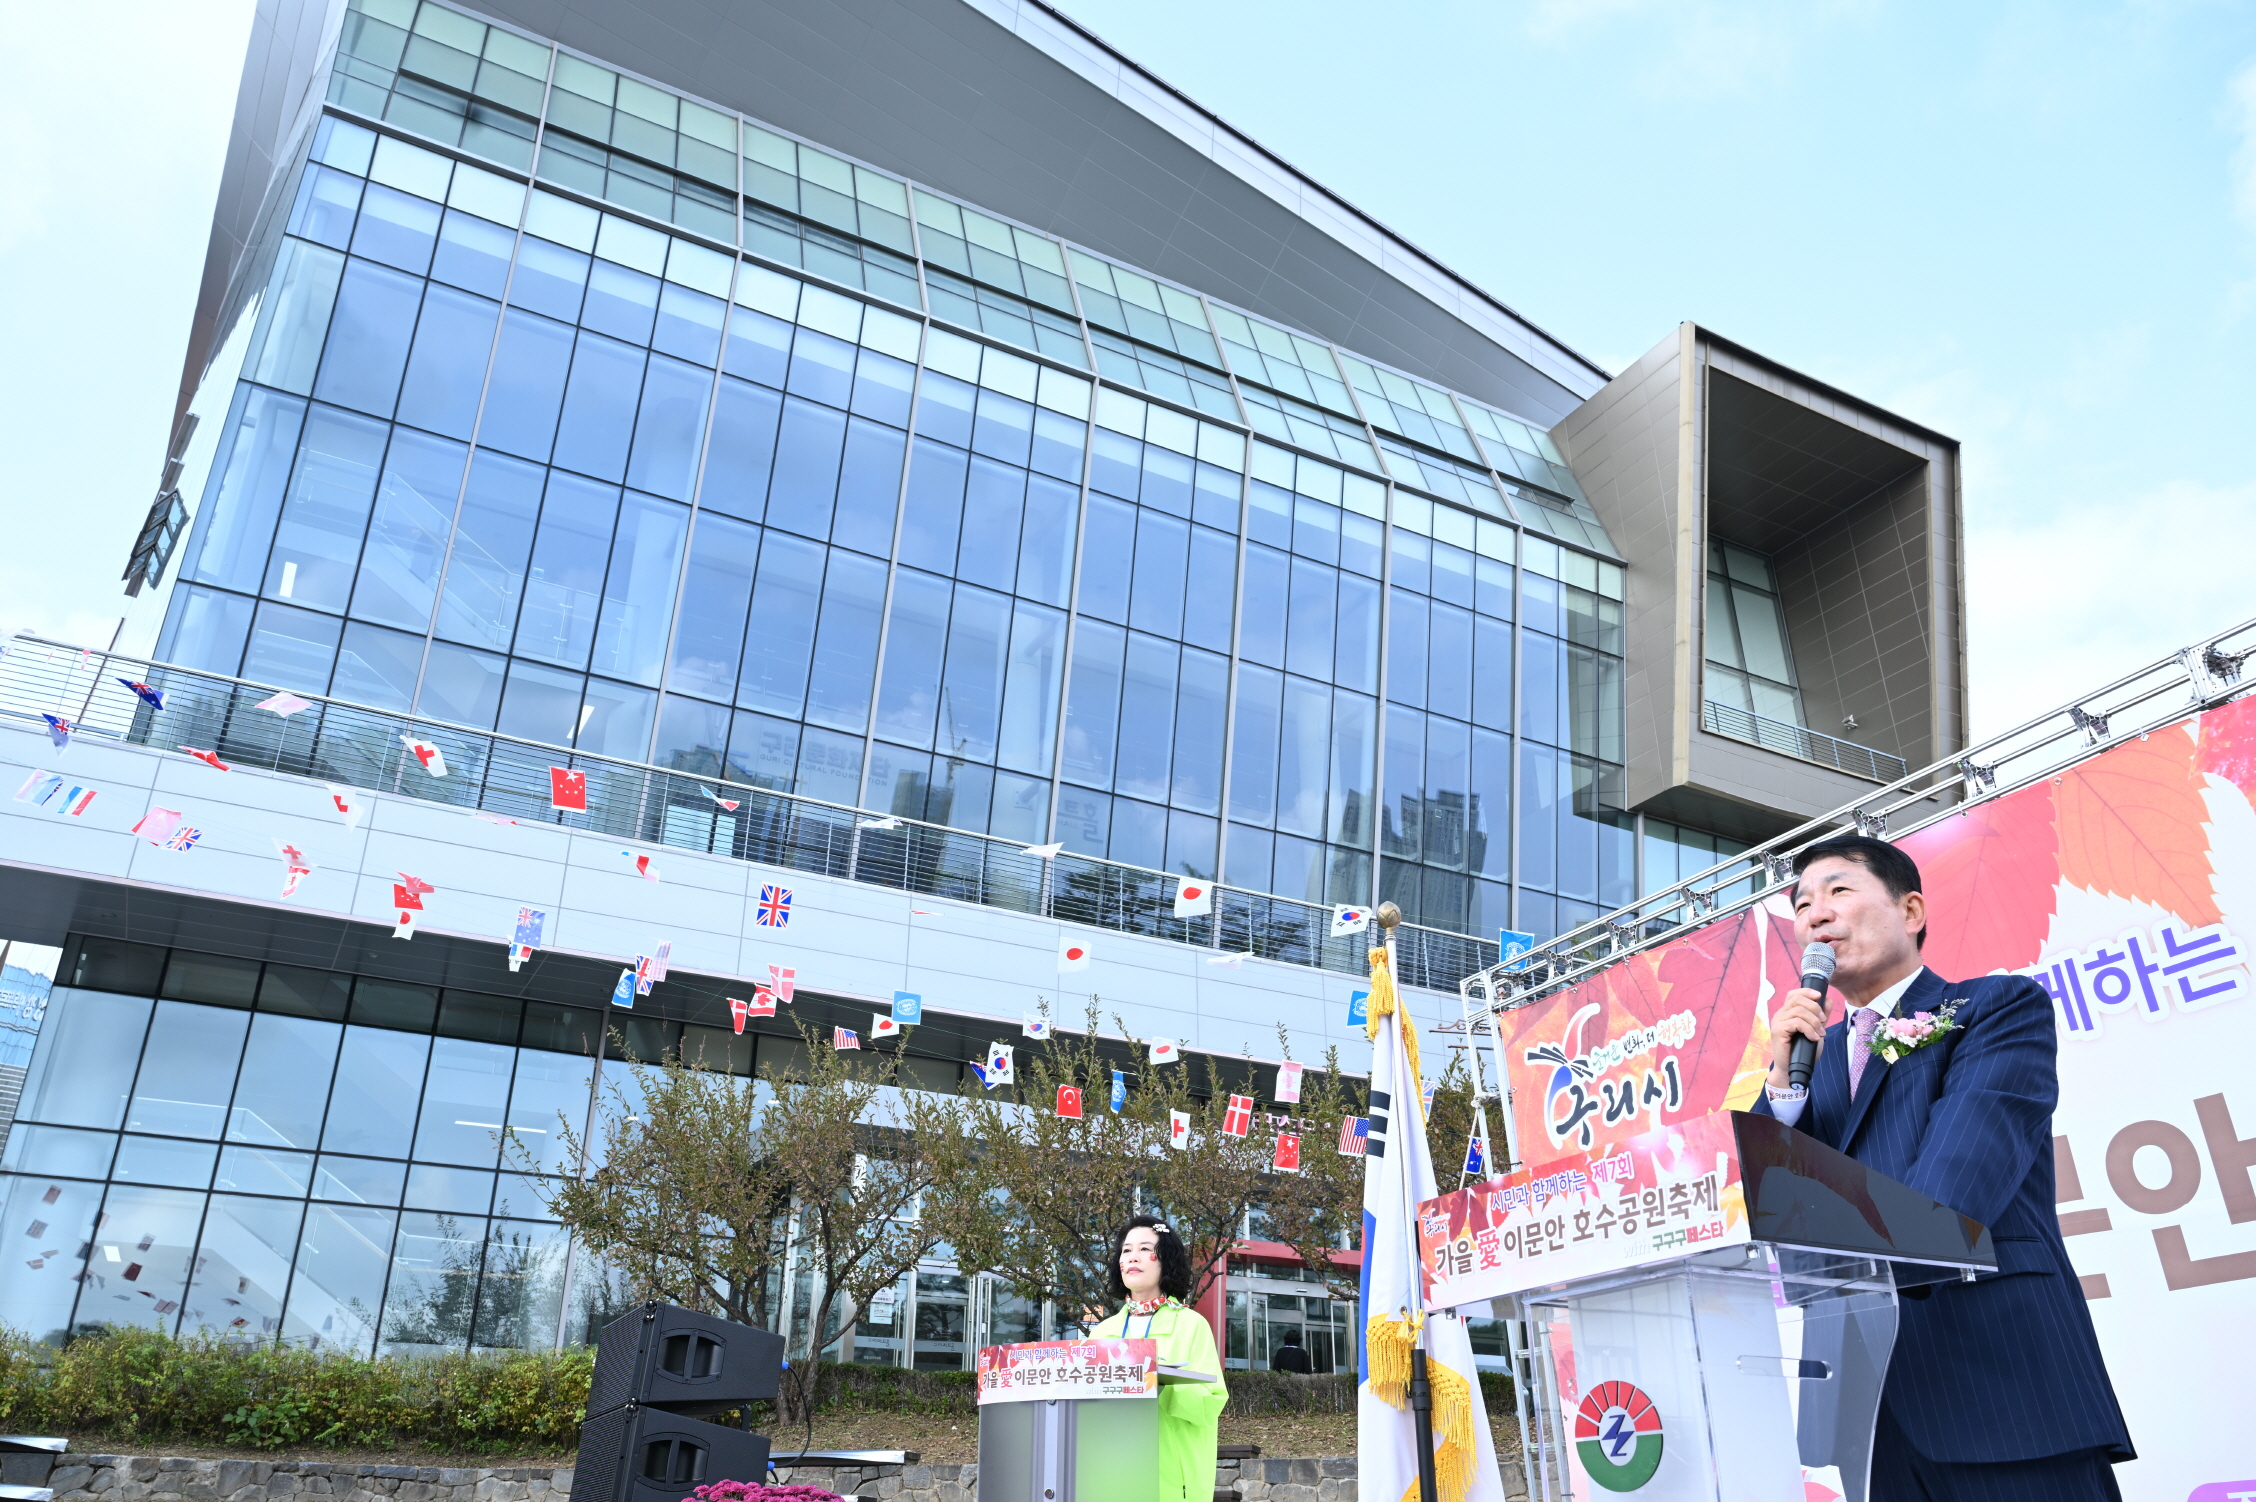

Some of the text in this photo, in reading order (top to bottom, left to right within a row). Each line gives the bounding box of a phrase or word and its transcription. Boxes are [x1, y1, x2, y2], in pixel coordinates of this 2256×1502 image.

[760, 753, 888, 787] GURI CUTURAL FOUNDTION
[1556, 1060, 1679, 1146] 구리시
[1492, 1154, 1633, 1211] 시민과 함께하는 제7회
[1436, 1174, 1720, 1276] 가을 愛 이문안 호수공원축제
[1652, 1220, 1724, 1252] 구구구페스타
[1010, 1346, 1096, 1360] 시민과 함께하는 제7회
[983, 1365, 1143, 1389] 가을 愛 이문안 호수공원축제
[1102, 1386, 1145, 1395] 구구구페스타
